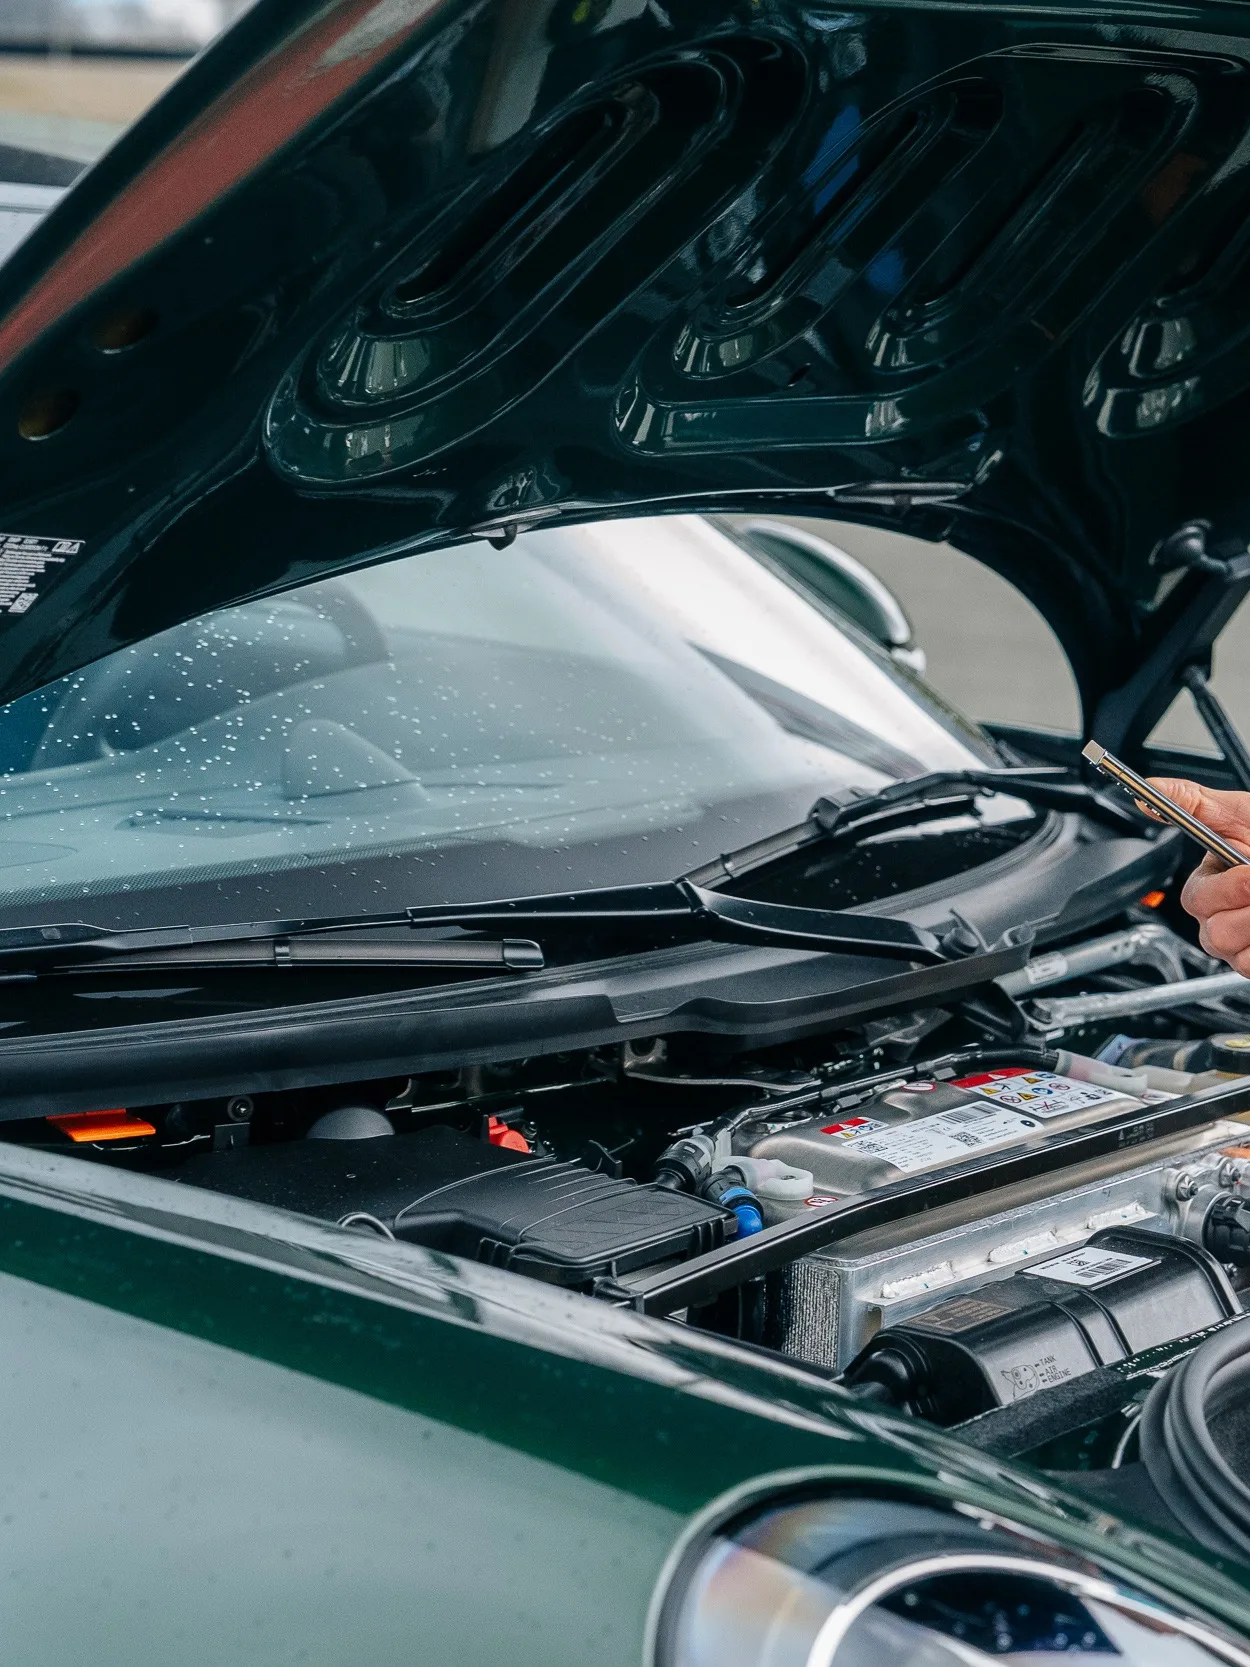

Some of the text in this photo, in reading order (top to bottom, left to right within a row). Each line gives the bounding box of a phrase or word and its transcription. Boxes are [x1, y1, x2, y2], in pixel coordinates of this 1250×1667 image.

[1040, 1354, 1056, 1366] TANK
[1045, 1365, 1058, 1376] AIR
[1047, 1368, 1071, 1383] ENGINE
